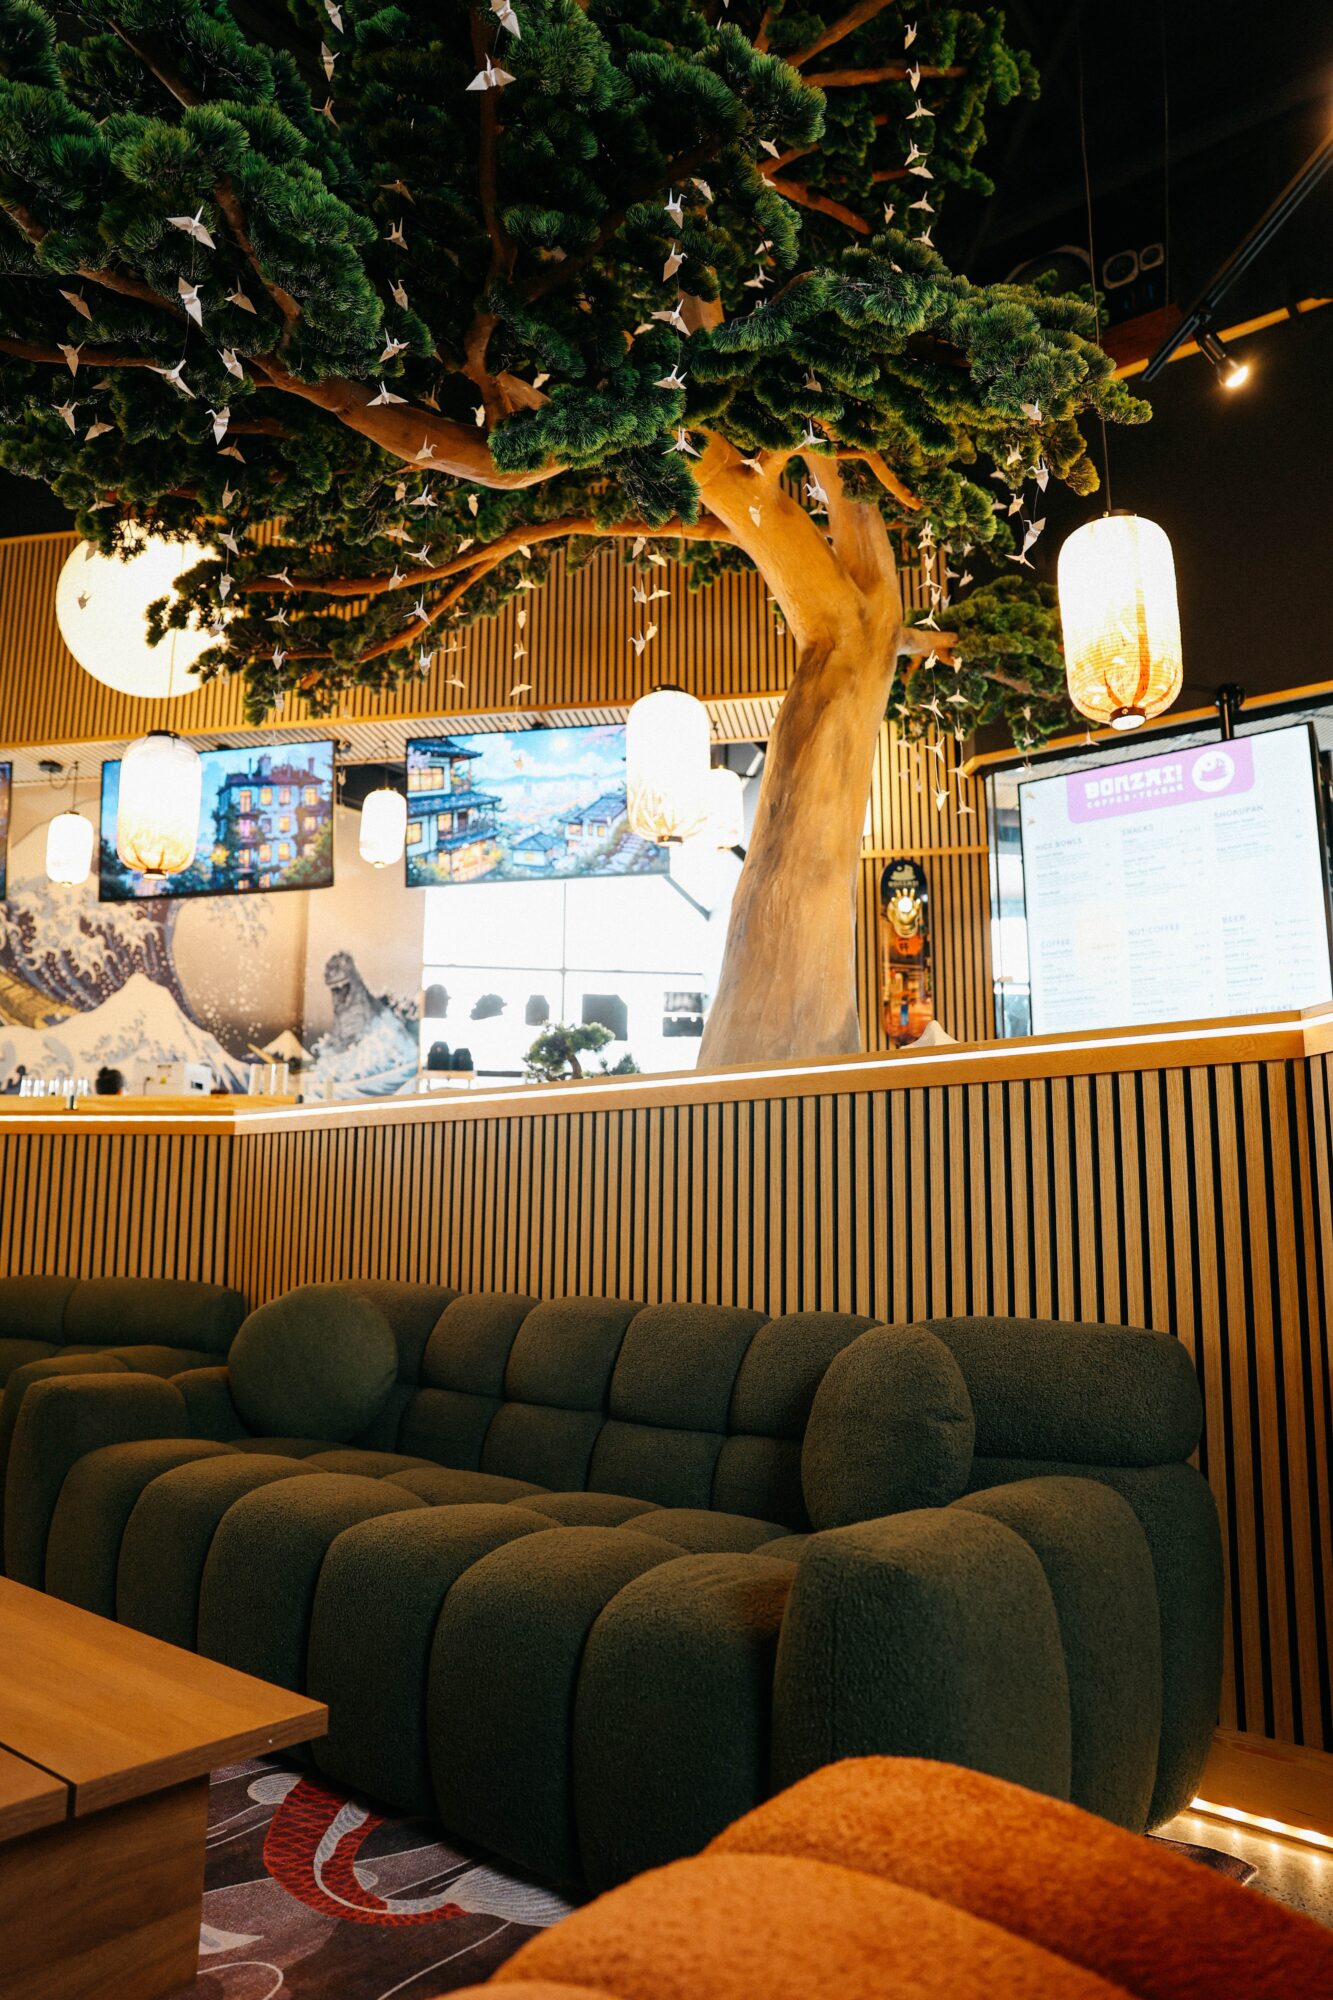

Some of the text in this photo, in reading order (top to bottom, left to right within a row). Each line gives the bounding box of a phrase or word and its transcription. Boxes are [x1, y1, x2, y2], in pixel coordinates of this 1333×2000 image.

[1084, 764, 1183, 800] BONZAI!
[1086, 794, 1130, 809] COFFEE
[1214, 804, 1264, 819] SHOKUPAN
